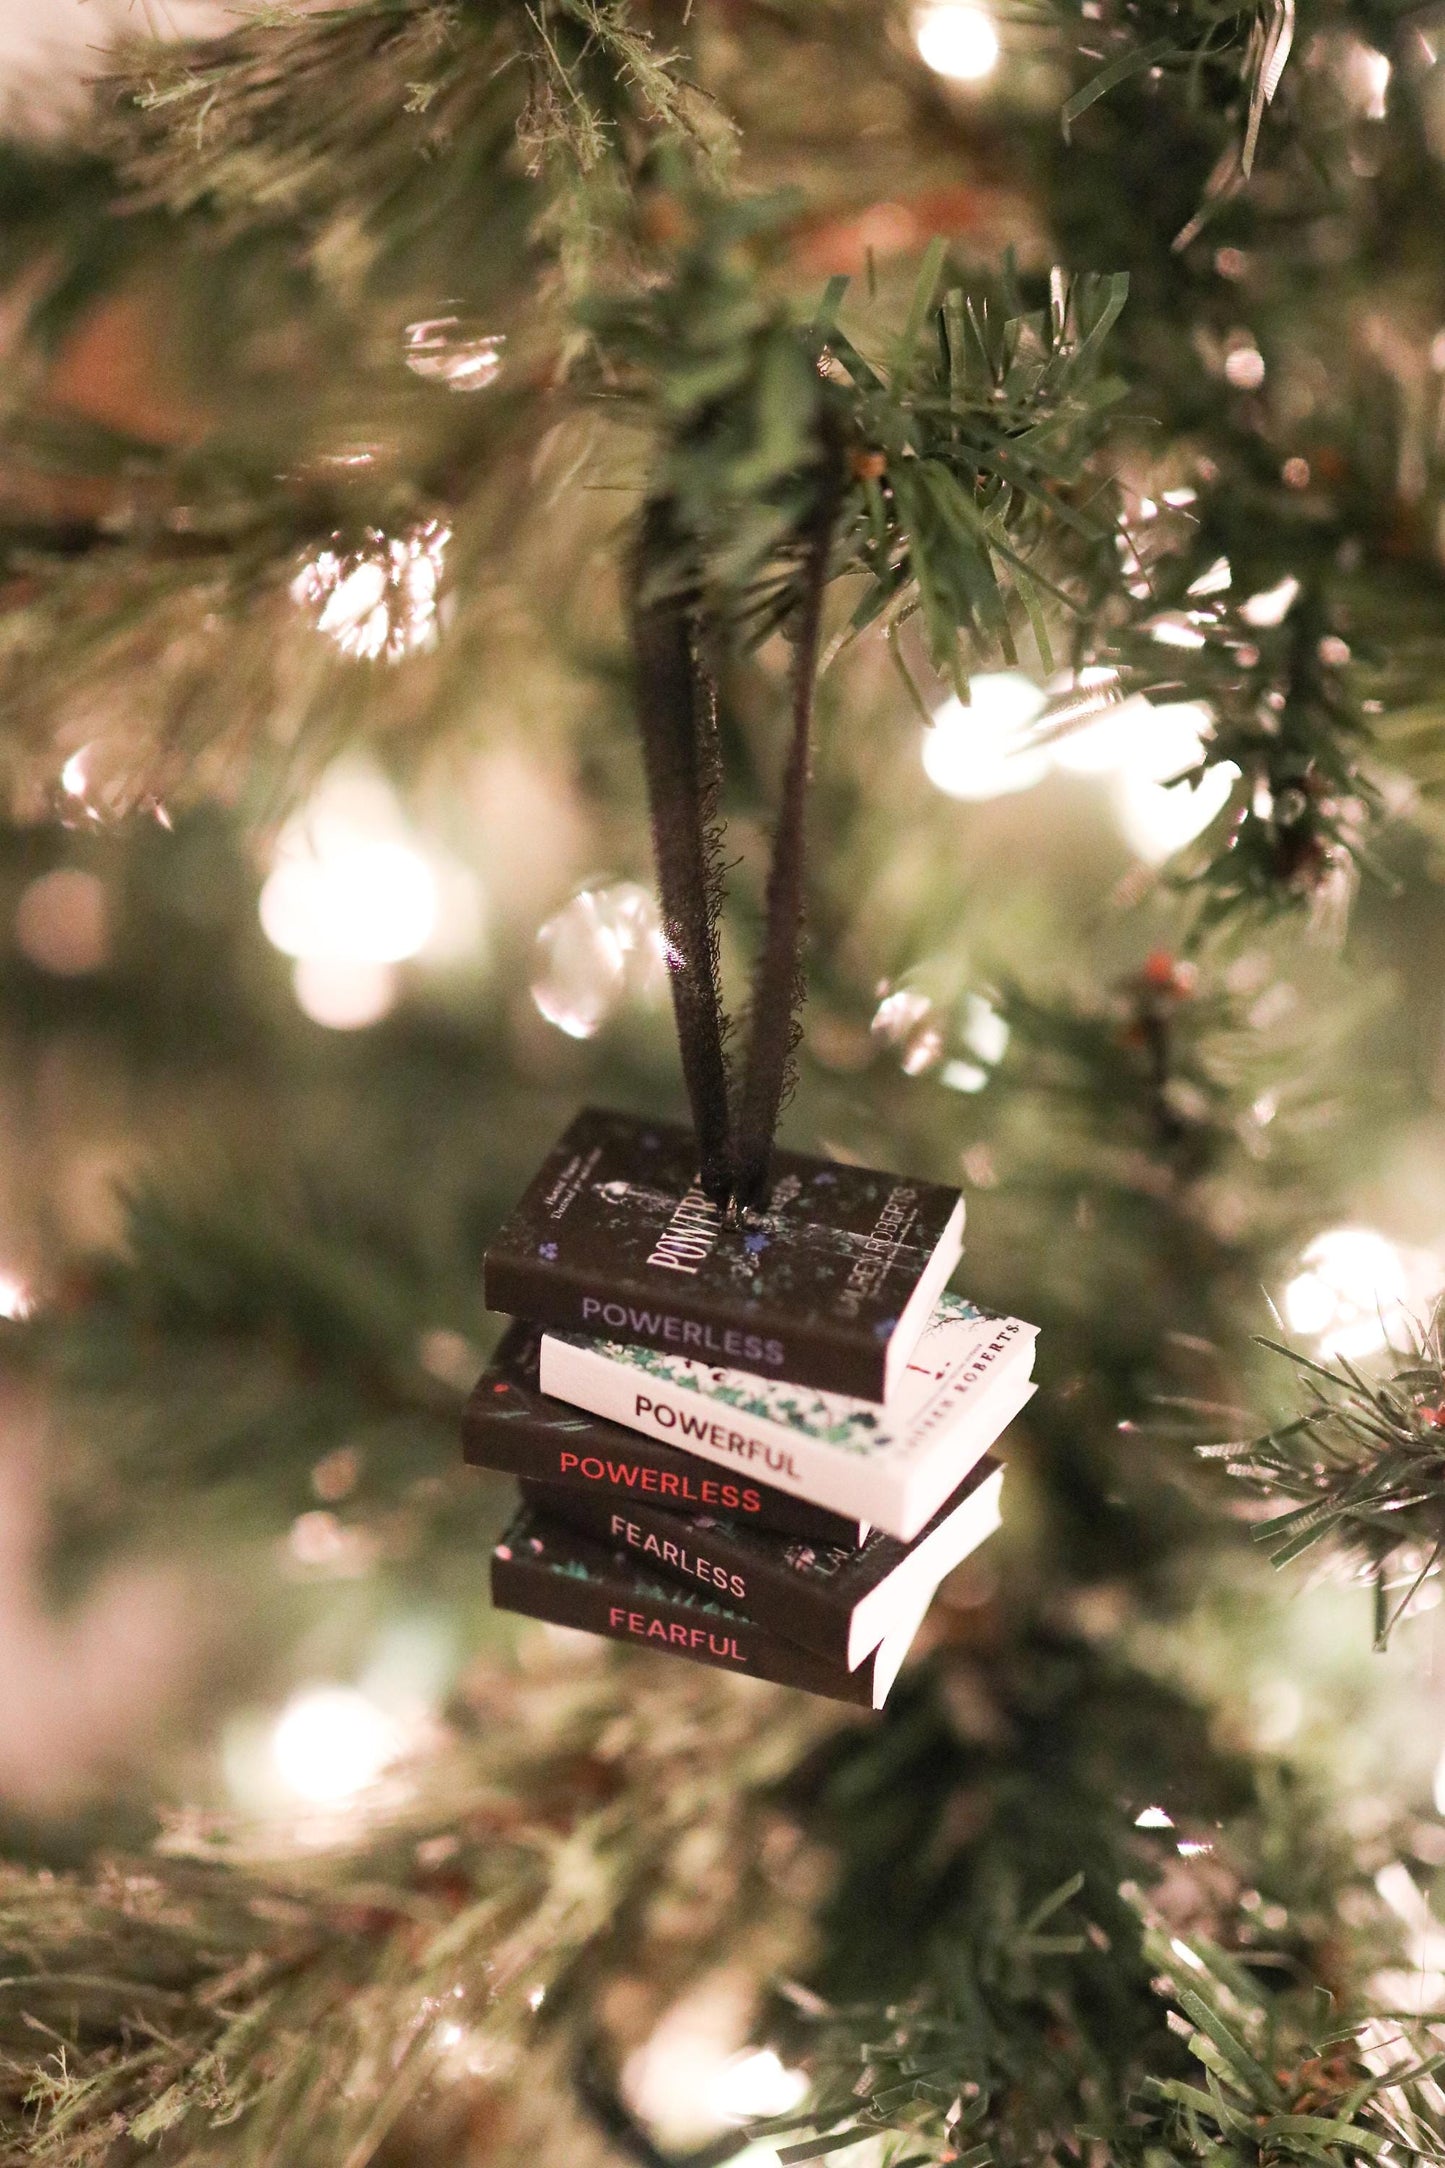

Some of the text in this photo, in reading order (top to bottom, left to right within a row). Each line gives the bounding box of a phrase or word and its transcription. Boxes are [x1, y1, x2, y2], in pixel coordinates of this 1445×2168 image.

[866, 1186, 918, 1255] ROBERTS
[581, 1295, 785, 1368] POWERLESS
[955, 1322, 1020, 1396] ROBERTS
[634, 1394, 803, 1480] POWERFUL
[559, 1452, 762, 1514] POWERLESS
[611, 1515, 747, 1599] FEARLESS
[608, 1606, 749, 1663] FEARFUL
